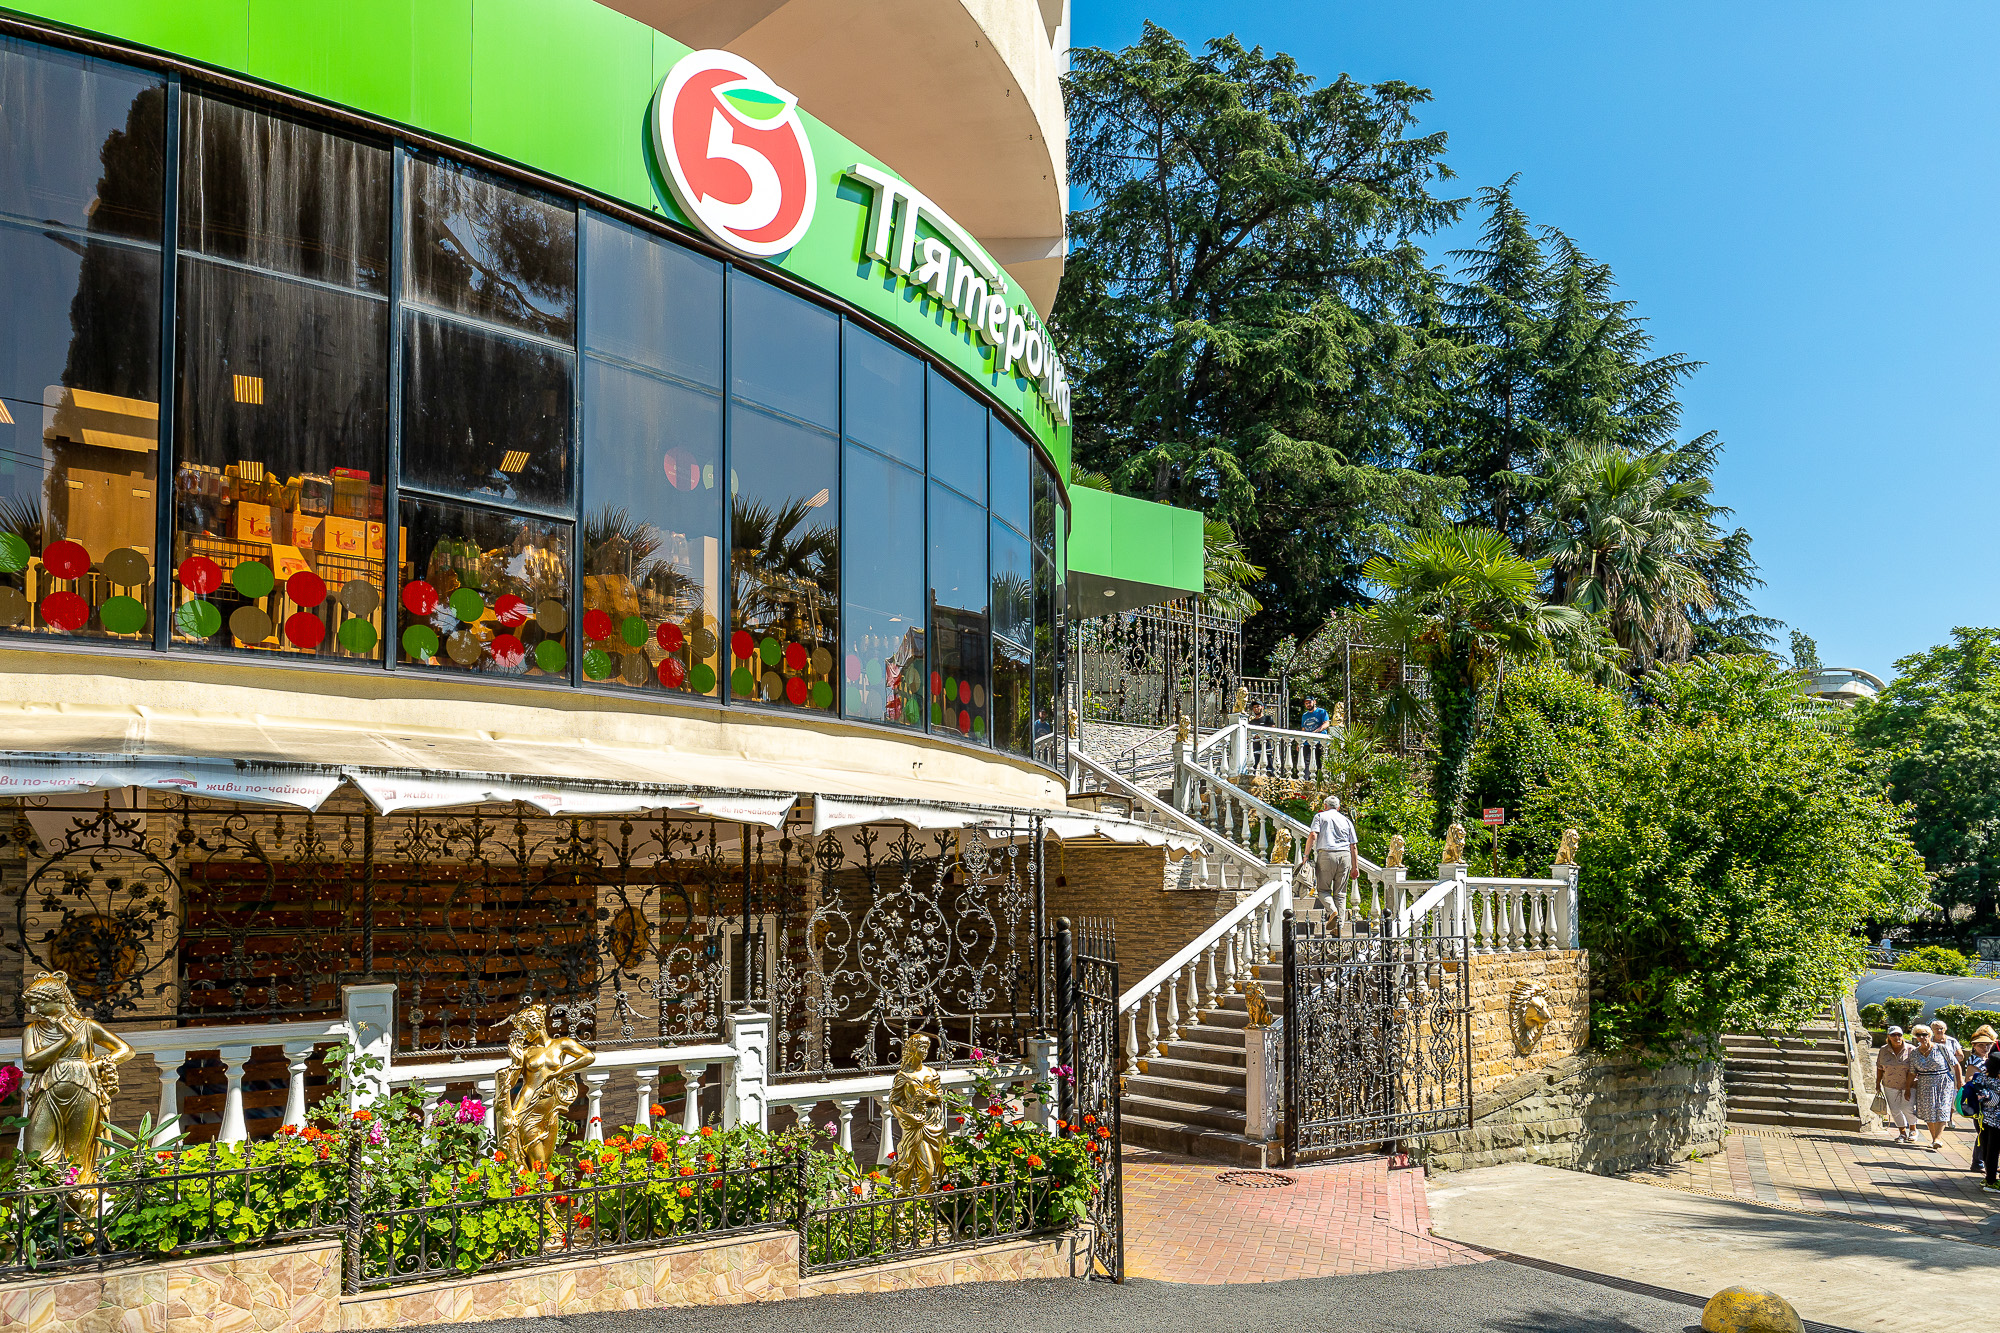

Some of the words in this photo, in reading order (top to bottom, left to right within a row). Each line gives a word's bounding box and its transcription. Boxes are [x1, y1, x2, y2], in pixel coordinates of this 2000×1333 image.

[699, 106, 782, 231] 5
[205, 782, 242, 792] живи
[403, 790, 433, 800] живи
